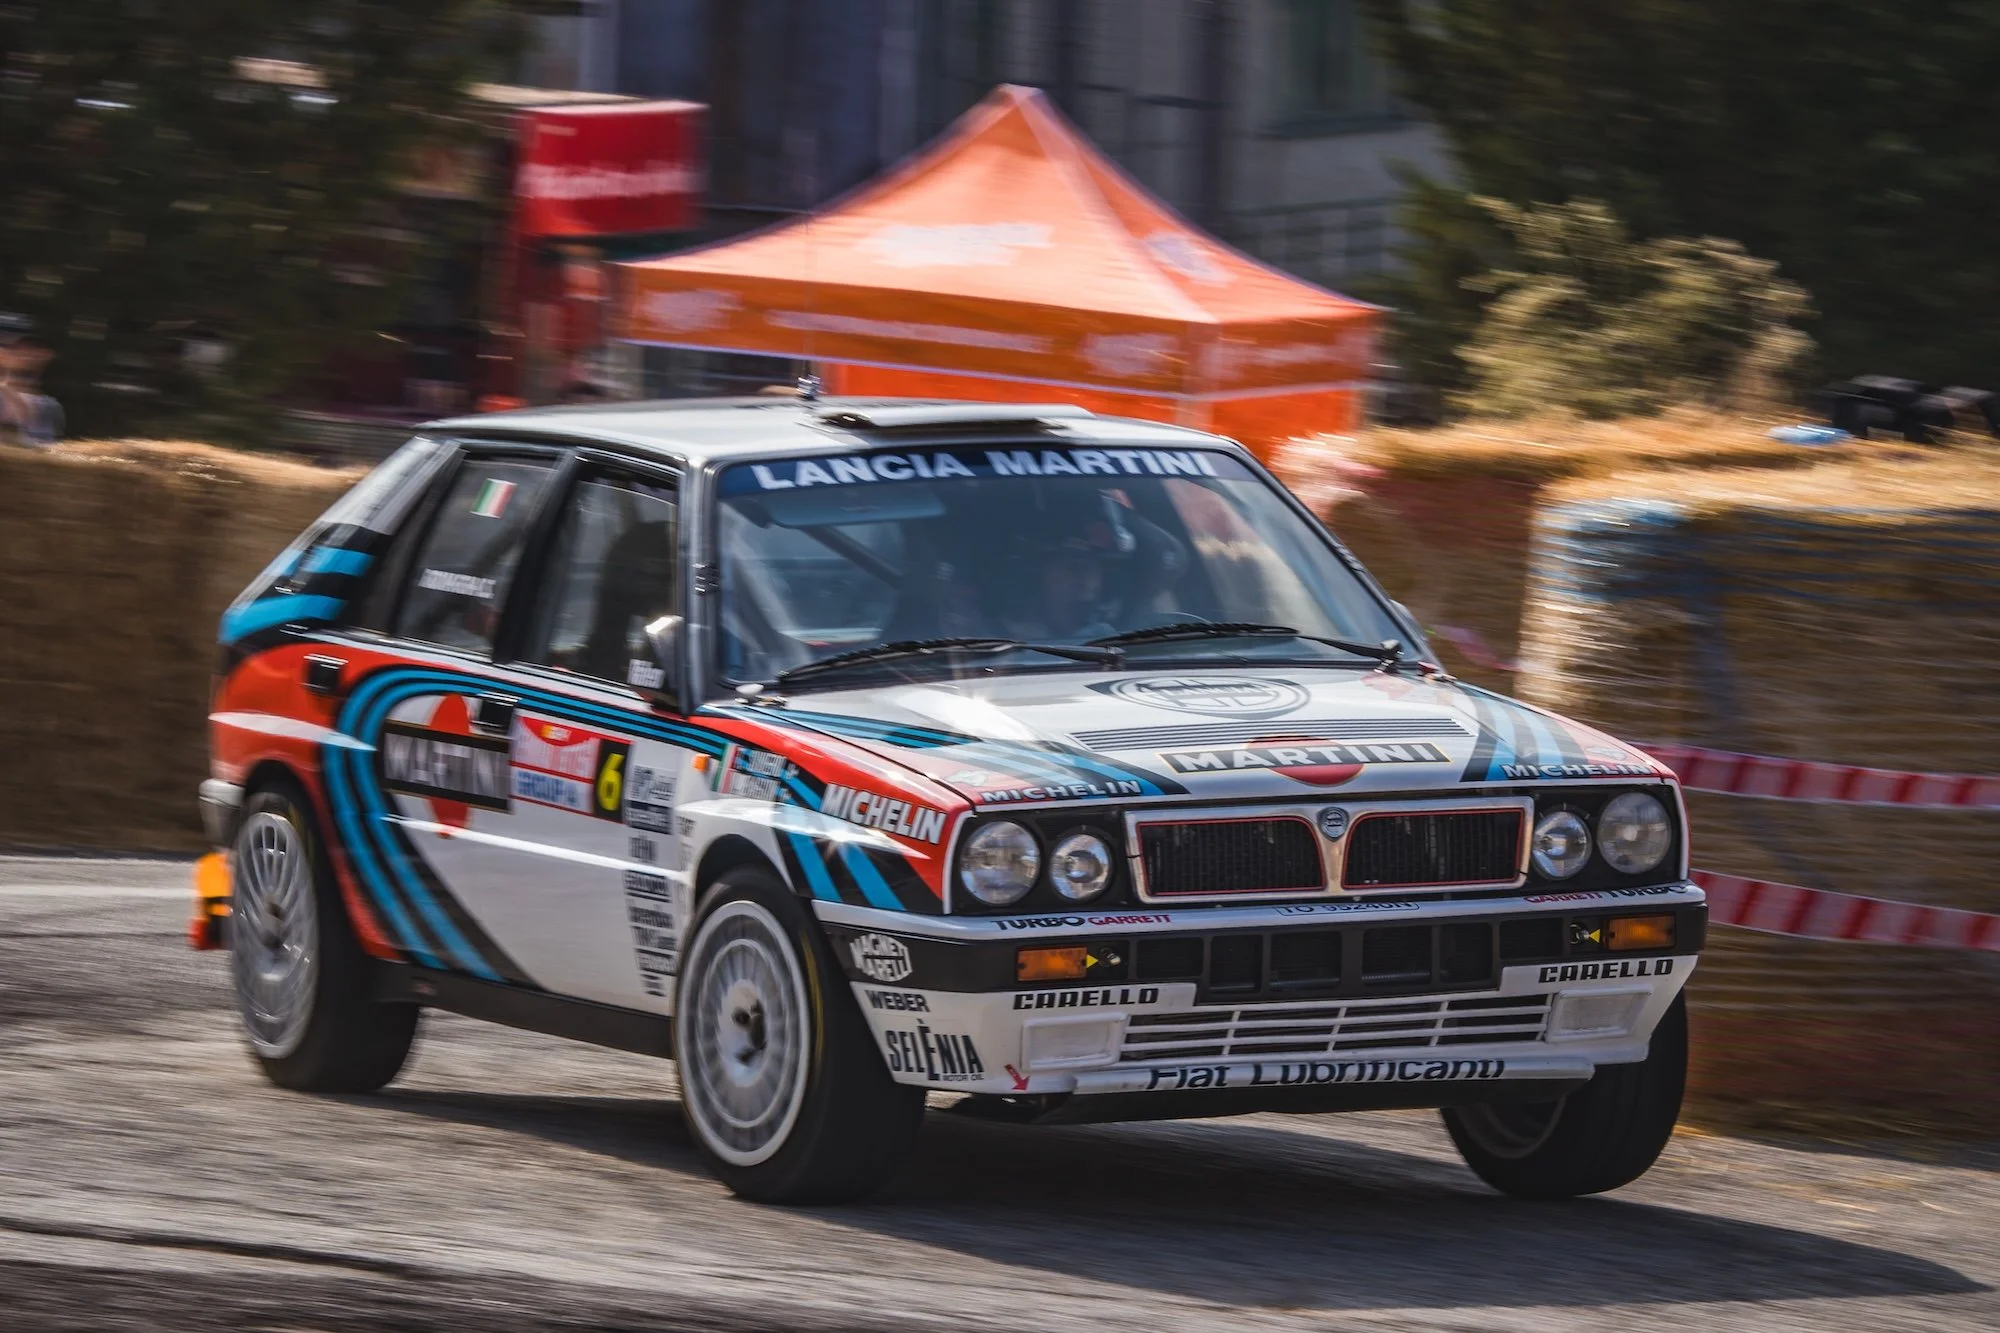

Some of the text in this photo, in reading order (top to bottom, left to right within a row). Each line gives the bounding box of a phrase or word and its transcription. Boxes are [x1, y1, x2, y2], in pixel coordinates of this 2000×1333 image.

[750, 450, 1219, 490] LANCIA MARTINI
[1170, 744, 1437, 772] MARTINI
[597, 753, 625, 811] 6
[1501, 764, 1654, 779] MICHELIN
[981, 780, 1141, 803] MICHELIN
[820, 783, 947, 845] MICHELIN
[1523, 884, 1689, 904] GARRETT TURBO
[989, 914, 1172, 930] TURBO GARRETT
[1538, 958, 1674, 984] CARELLO
[865, 989, 931, 1013] WEBER
[1013, 987, 1160, 1011] CARELLO
[1145, 1058, 1506, 1090] Fiat Lubrificanti
